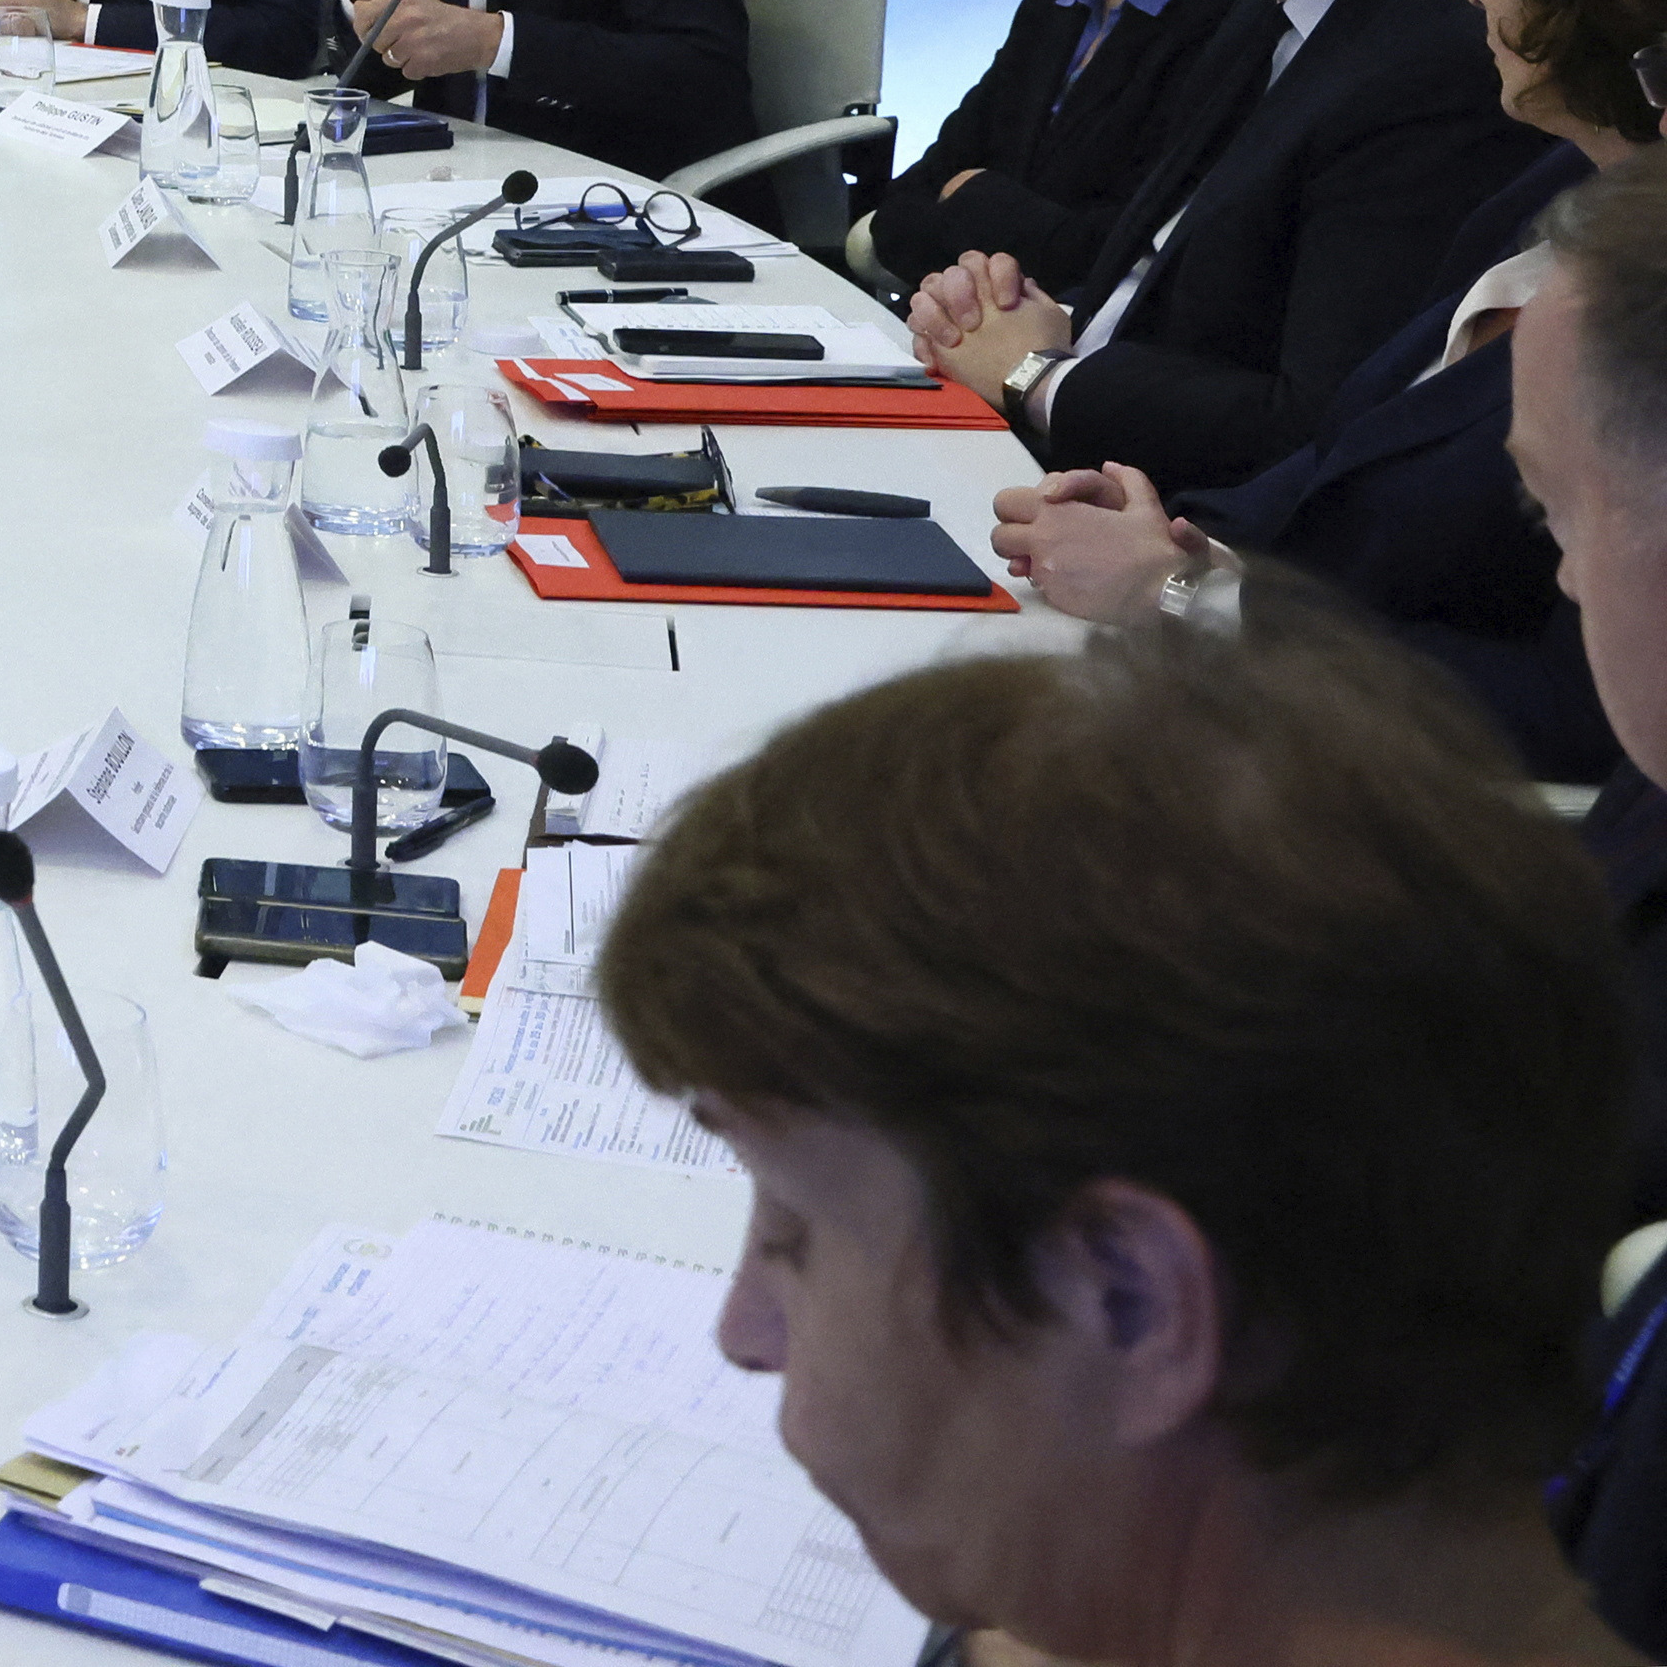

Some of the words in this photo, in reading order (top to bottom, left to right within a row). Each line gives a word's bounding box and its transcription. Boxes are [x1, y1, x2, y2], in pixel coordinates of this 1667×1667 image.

[67, 110, 104, 126] GUSTIN
[86, 766, 116, 805] Stéphane
[104, 730, 135, 773] BOUILLON
